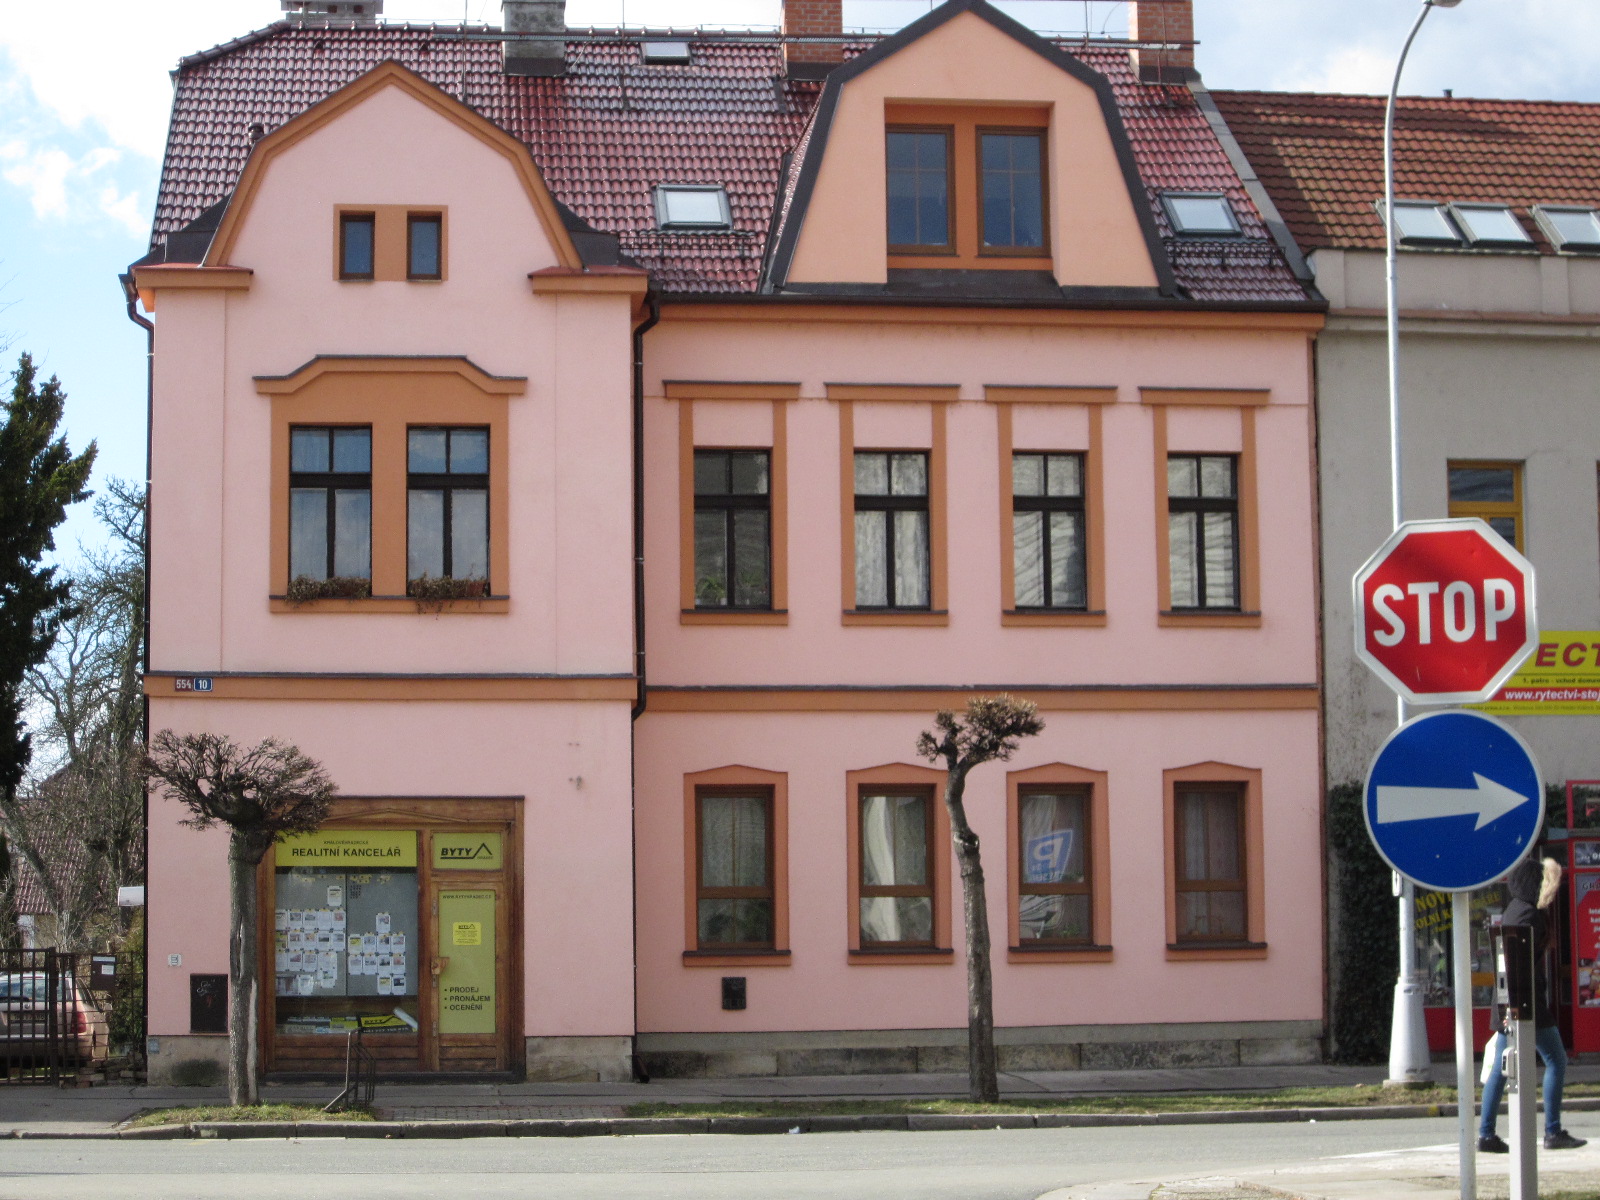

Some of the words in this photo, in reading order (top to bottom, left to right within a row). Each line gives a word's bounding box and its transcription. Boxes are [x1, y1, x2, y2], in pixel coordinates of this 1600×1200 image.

[1372, 577, 1516, 647] STOP
[176, 679, 192, 689] 554
[198, 679, 208, 690] 10
[292, 846, 340, 857] REALITNÍ
[343, 846, 401, 857] KANCELÁŘ
[440, 847, 472, 856] BYTY
[449, 994, 491, 1002] PRONÁJEM
